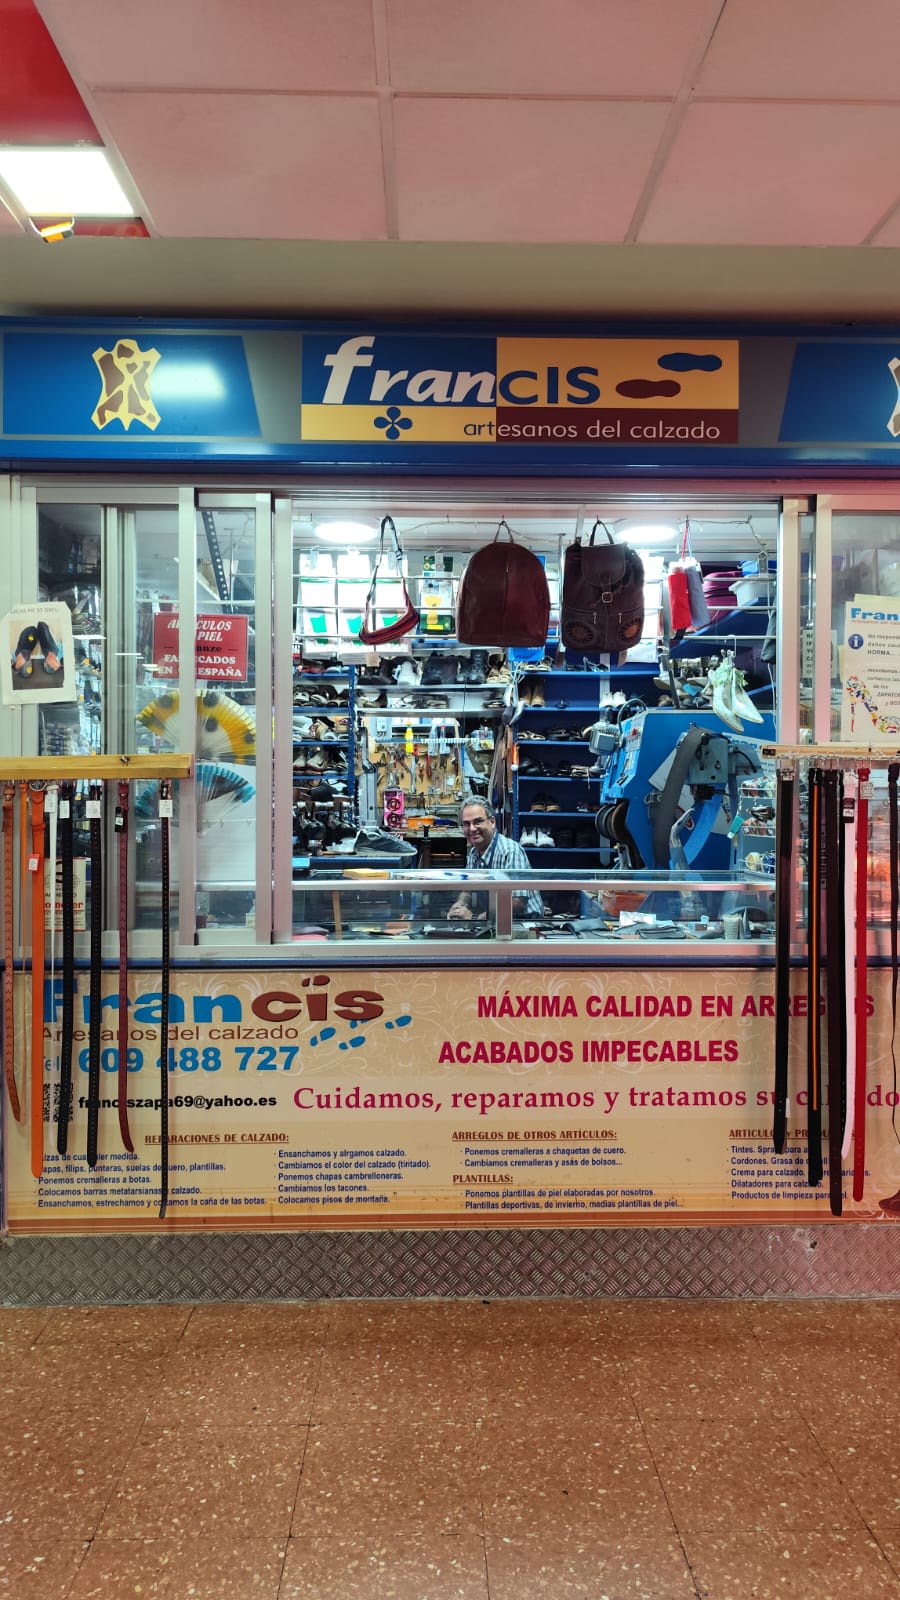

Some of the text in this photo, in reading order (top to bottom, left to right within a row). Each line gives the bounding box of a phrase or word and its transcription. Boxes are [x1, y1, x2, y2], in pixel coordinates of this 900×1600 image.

[463, 419, 720, 439] artesanos del calzado
[167, 619, 232, 631] ACULOS
[197, 631, 223, 641] PIEL
[164, 654, 236, 665] FACADOS
[197, 666, 242, 677] ESPAÑA
[42, 976, 384, 1023] Francis
[477, 990, 578, 1018] MÁXIMA
[586, 995, 692, 1017] CALIDAD
[701, 995, 733, 1017] EN
[168, 1025, 199, 1040] del
[208, 1024, 299, 1041] calzado
[438, 1040, 739, 1063] ACABADOS IMPECABLES
[78, 1047, 144, 1072] 609
[156, 1047, 222, 1072] 488
[234, 1046, 299, 1071] 727
[293, 1086, 443, 1112] Cuidamos,
[451, 1090, 595, 1115] reparamos
[604, 1091, 620, 1114] y
[629, 1087, 747, 1106] tratamos
[224, 1133, 238, 1142] DE
[241, 1132, 290, 1142] CALZADO:
[452, 1131, 504, 1140] ARREGLOS
[507, 1131, 521, 1139] DE
[524, 1131, 557, 1139] OTROS
[278, 1150, 331, 1158] Ensanchamos
[501, 1147, 544, 1155] cremalleras
[552, 1147, 590, 1156] chaquetas
[278, 1161, 322, 1169] Cambiamos
[368, 1160, 396, 1168] calzado
[464, 1159, 508, 1167] Cambiamos
[510, 1158, 553, 1166] cremalleras
[771, 1157, 792, 1165] Grasa
[731, 1168, 754, 1176] Crema
[278, 1173, 313, 1181] Ponemos
[315, 1172, 342, 1182] chapas
[453, 1174, 513, 1182] PLANTILLAS:
[278, 1184, 322, 1192] Cambiamos
[324, 1184, 335, 1192] los
[731, 1180, 773, 1188] Dilatadores
[38, 1188, 81, 1196] Colocamos
[465, 1190, 499, 1198] Ponemos
[502, 1189, 535, 1198] plantillas
[548, 1189, 561, 1197] piel
[563, 1188, 604, 1196] elaboradas
[731, 1191, 769, 1199] Productos
[771, 1191, 780, 1199] de
[782, 1191, 813, 1200] limpieza
[96, 1199, 144, 1207] estrechamos
[278, 1196, 320, 1204] Colocamos
[322, 1195, 342, 1204] pisos
[344, 1195, 353, 1203] de
[465, 1201, 499, 1209] Plantillas
[589, 1200, 615, 1208] medias
[617, 1200, 651, 1209] plantillas
